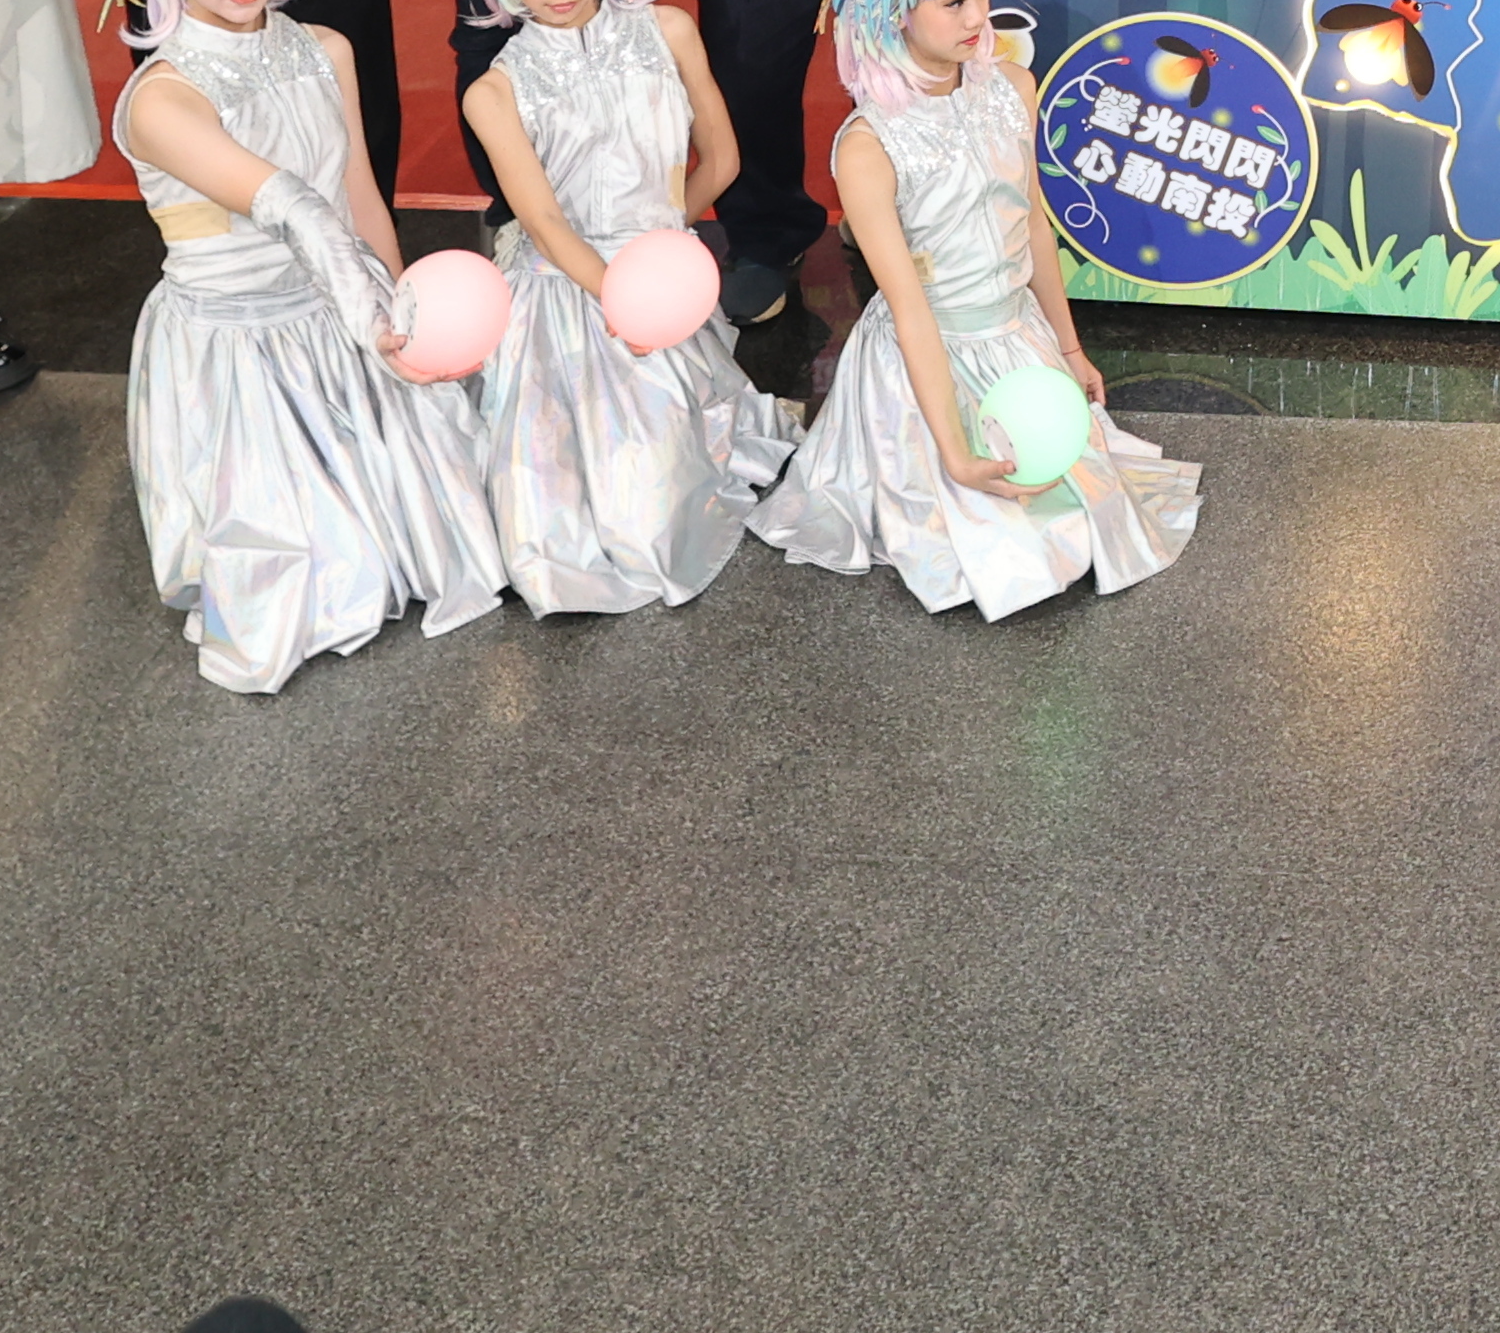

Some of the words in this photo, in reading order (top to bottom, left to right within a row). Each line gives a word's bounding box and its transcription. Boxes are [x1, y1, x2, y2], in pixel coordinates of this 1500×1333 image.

[1071, 136, 1260, 240] 心動南投
[1088, 83, 1279, 193] 螢光閃閃
